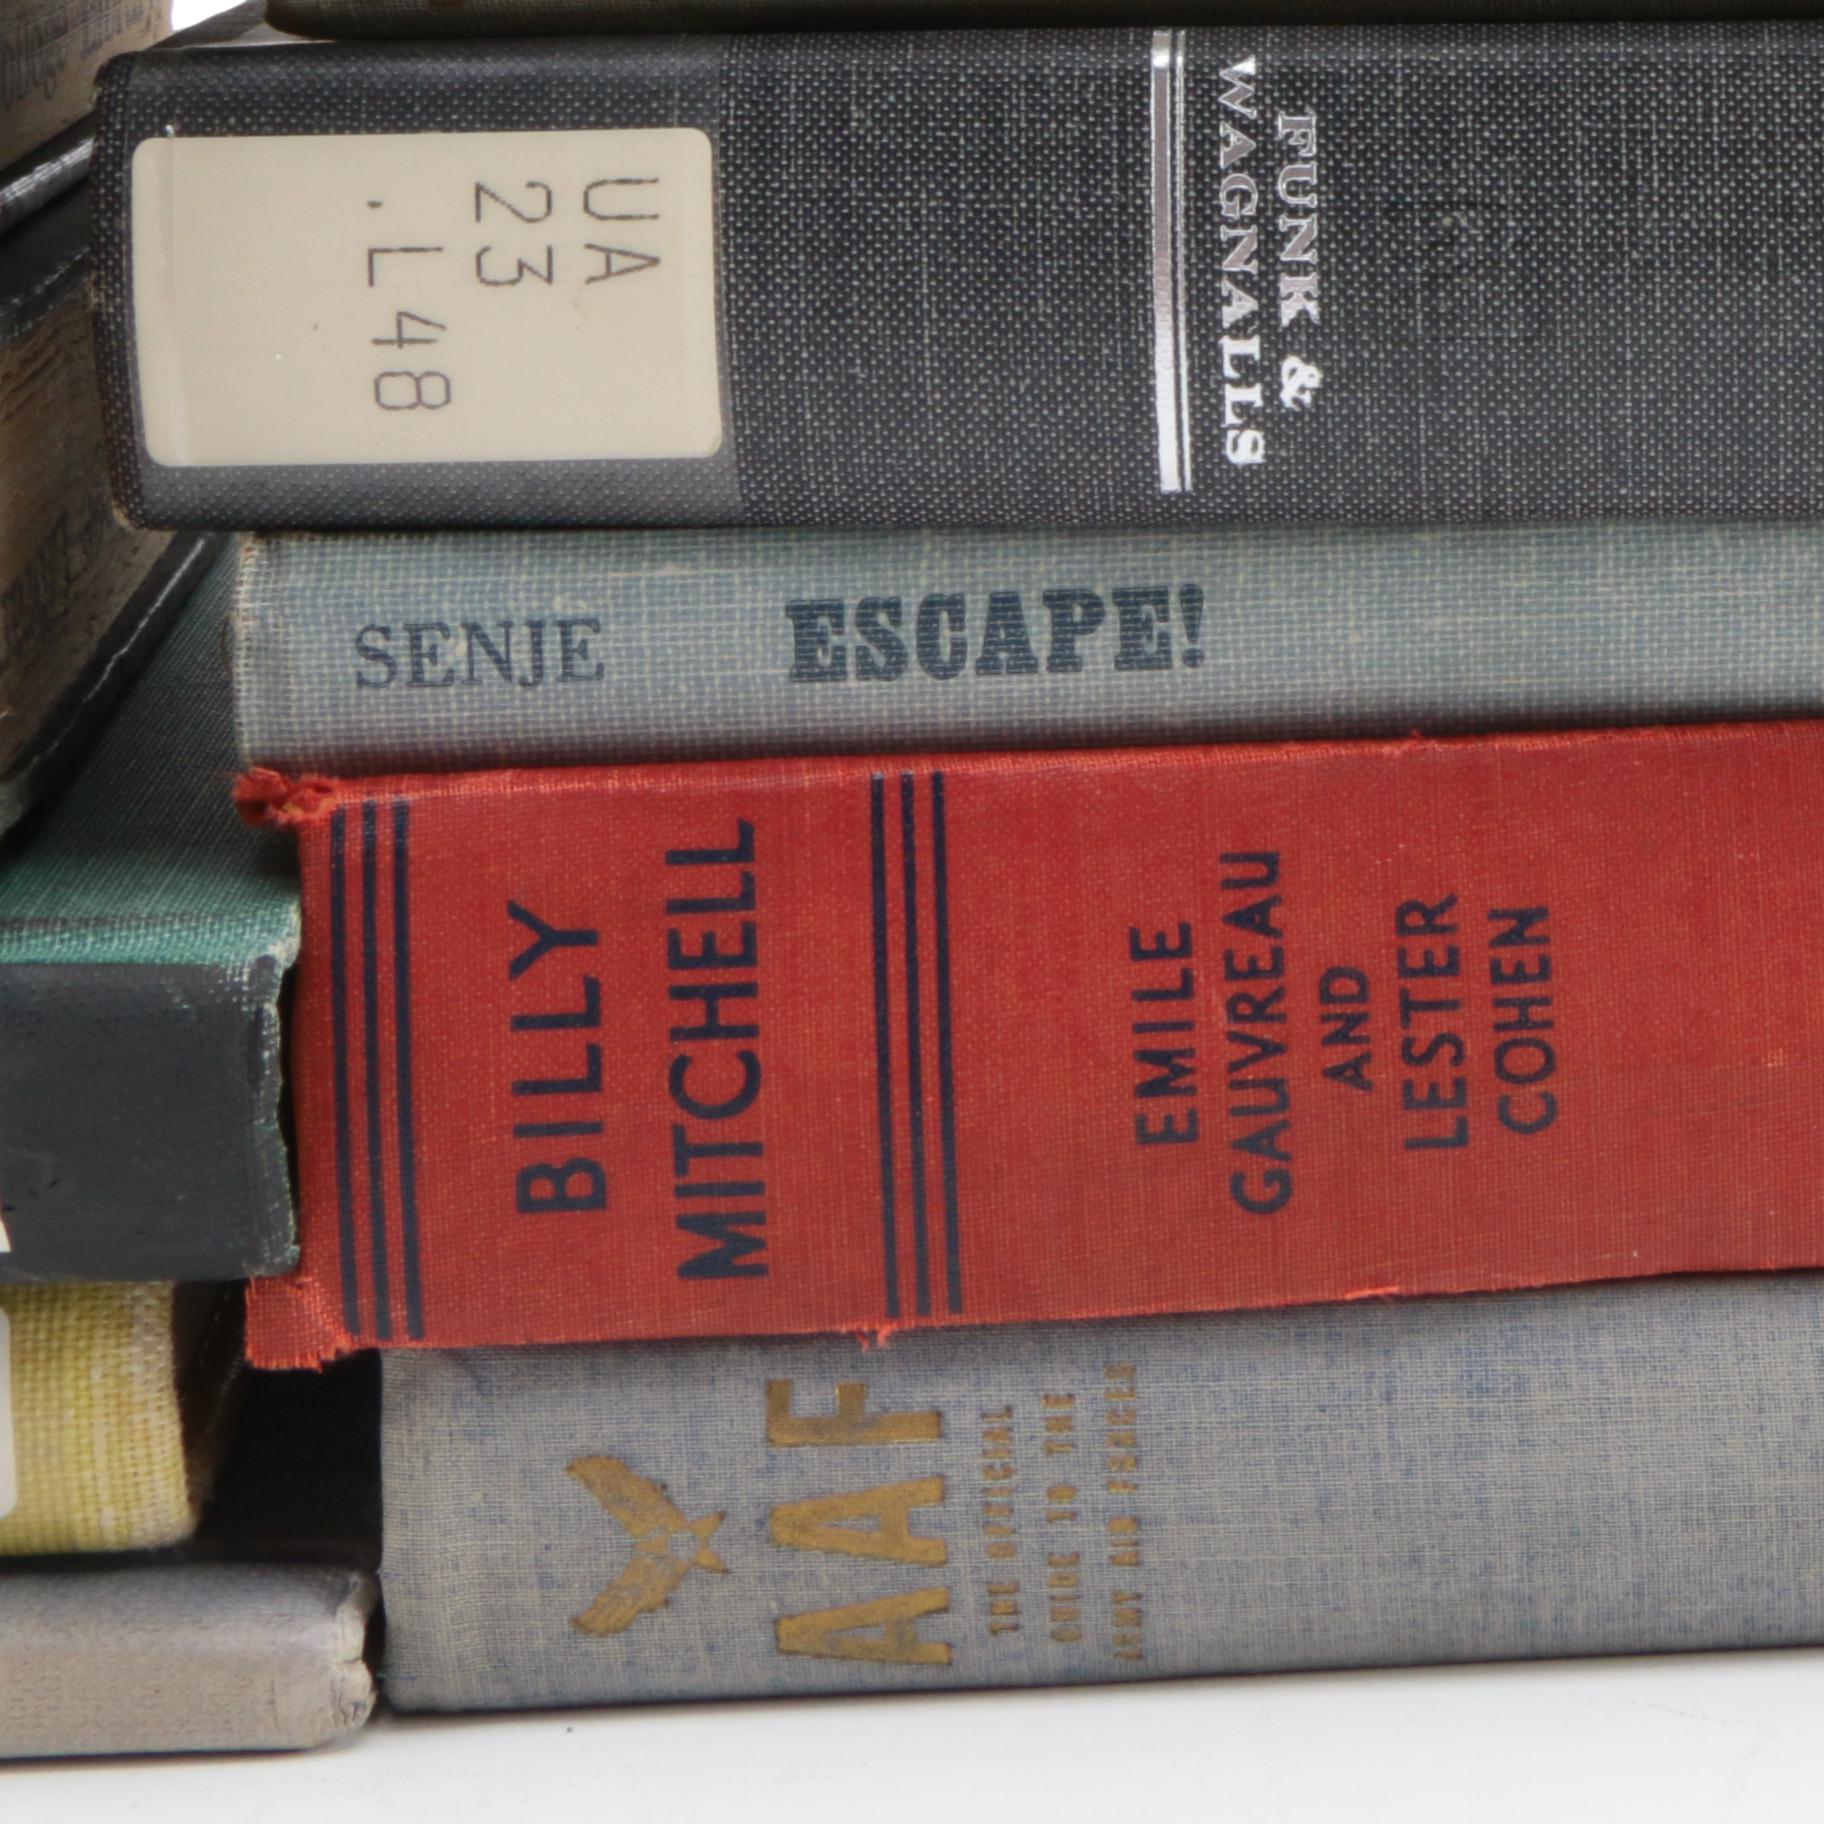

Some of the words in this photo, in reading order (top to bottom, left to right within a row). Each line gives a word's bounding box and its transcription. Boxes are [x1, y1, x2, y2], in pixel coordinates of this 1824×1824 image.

[366, 198, 452, 413] .L48
[475, 180, 554, 288] 23
[583, 176, 661, 285] UA
[1217, 54, 1266, 466] WAGNALLS
[1277, 110, 1320, 324] FUNK
[1280, 355, 1323, 408] &
[354, 617, 604, 689] SENJE
[784, 583, 1205, 683] ESCAPE!
[507, 899, 607, 1214] BILLY
[665, 818, 770, 1281] MITCHELL
[1129, 919, 1198, 1147] EMILE
[1220, 849, 1294, 1215] GAUVREAU
[1321, 963, 1375, 1092] AND
[1395, 893, 1470, 1150] LESTER
[1487, 903, 1559, 1135] COHEN
[764, 1378, 954, 1665] AAF
[1040, 1393, 1077, 1456] THE
[1045, 1483, 1078, 1523] TO
[989, 1580, 1020, 1637] THE
